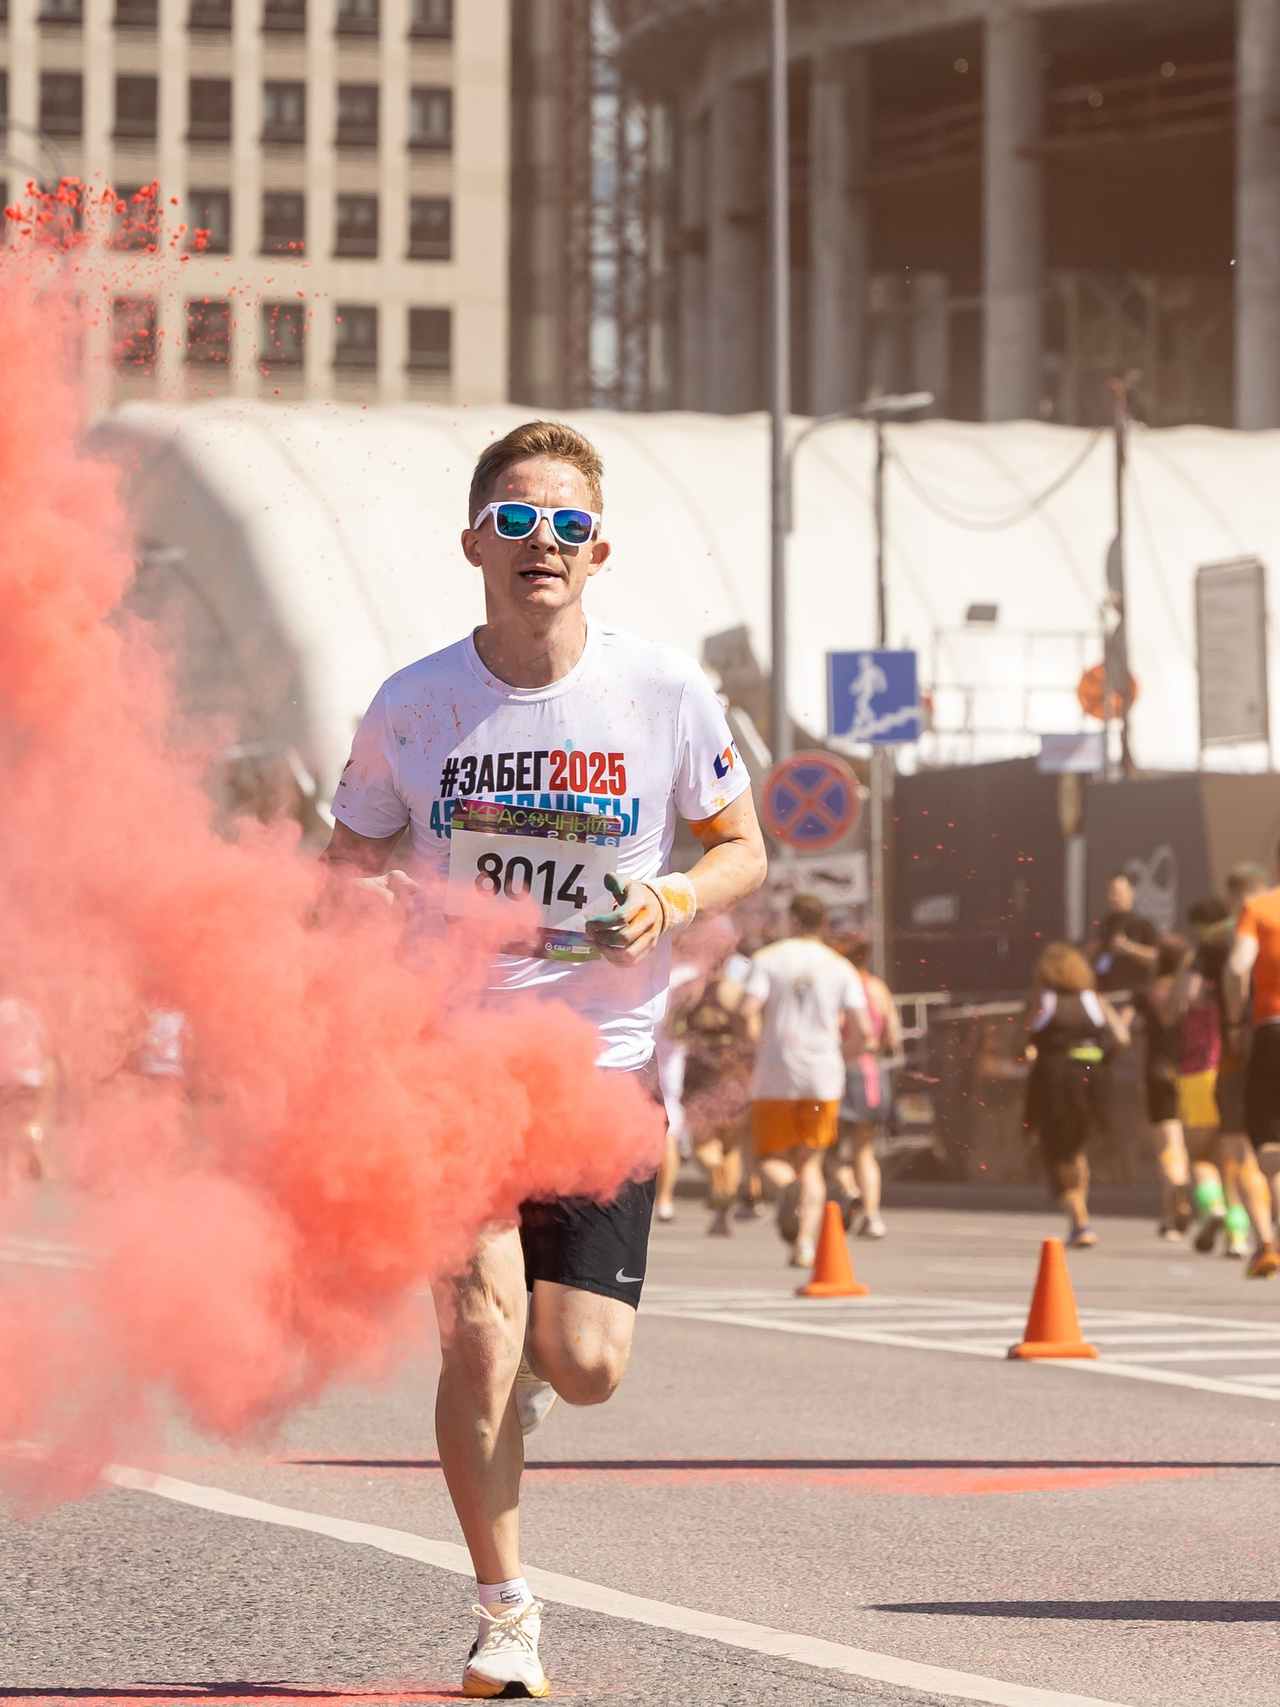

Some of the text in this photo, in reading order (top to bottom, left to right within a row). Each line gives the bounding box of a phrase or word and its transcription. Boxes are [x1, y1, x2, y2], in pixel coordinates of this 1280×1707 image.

[440, 749, 627, 799] #ЗАБЕГ2025
[468, 803, 608, 835] КРАСОЧНЫЙ
[547, 830, 617, 847] 2026
[474, 852, 588, 909] 8014
